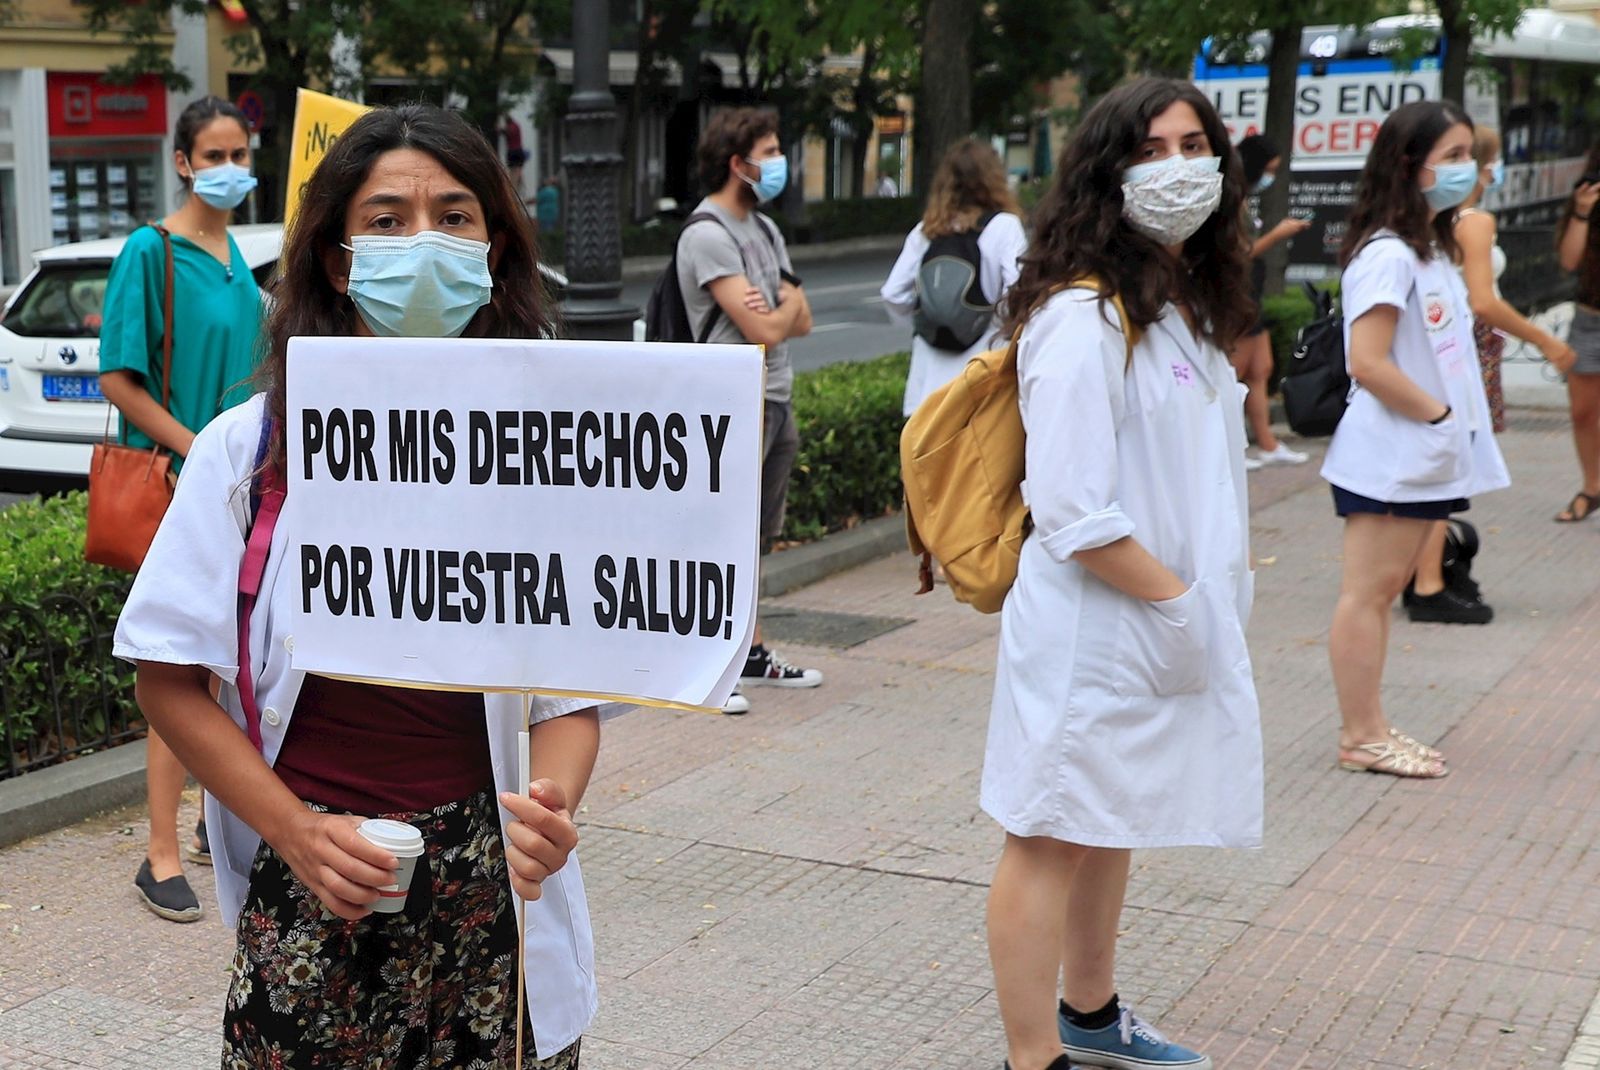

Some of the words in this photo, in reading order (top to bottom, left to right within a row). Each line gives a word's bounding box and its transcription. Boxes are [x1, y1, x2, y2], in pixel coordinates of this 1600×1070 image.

[1339, 83, 1425, 114] END
[302, 408, 378, 482] POR
[388, 408, 456, 484] MIS
[469, 410, 688, 493] DERECHOS
[700, 414, 731, 493] Y
[301, 544, 375, 617] POR
[383, 547, 571, 626] VUESTRA
[593, 553, 736, 640] SALUD!
